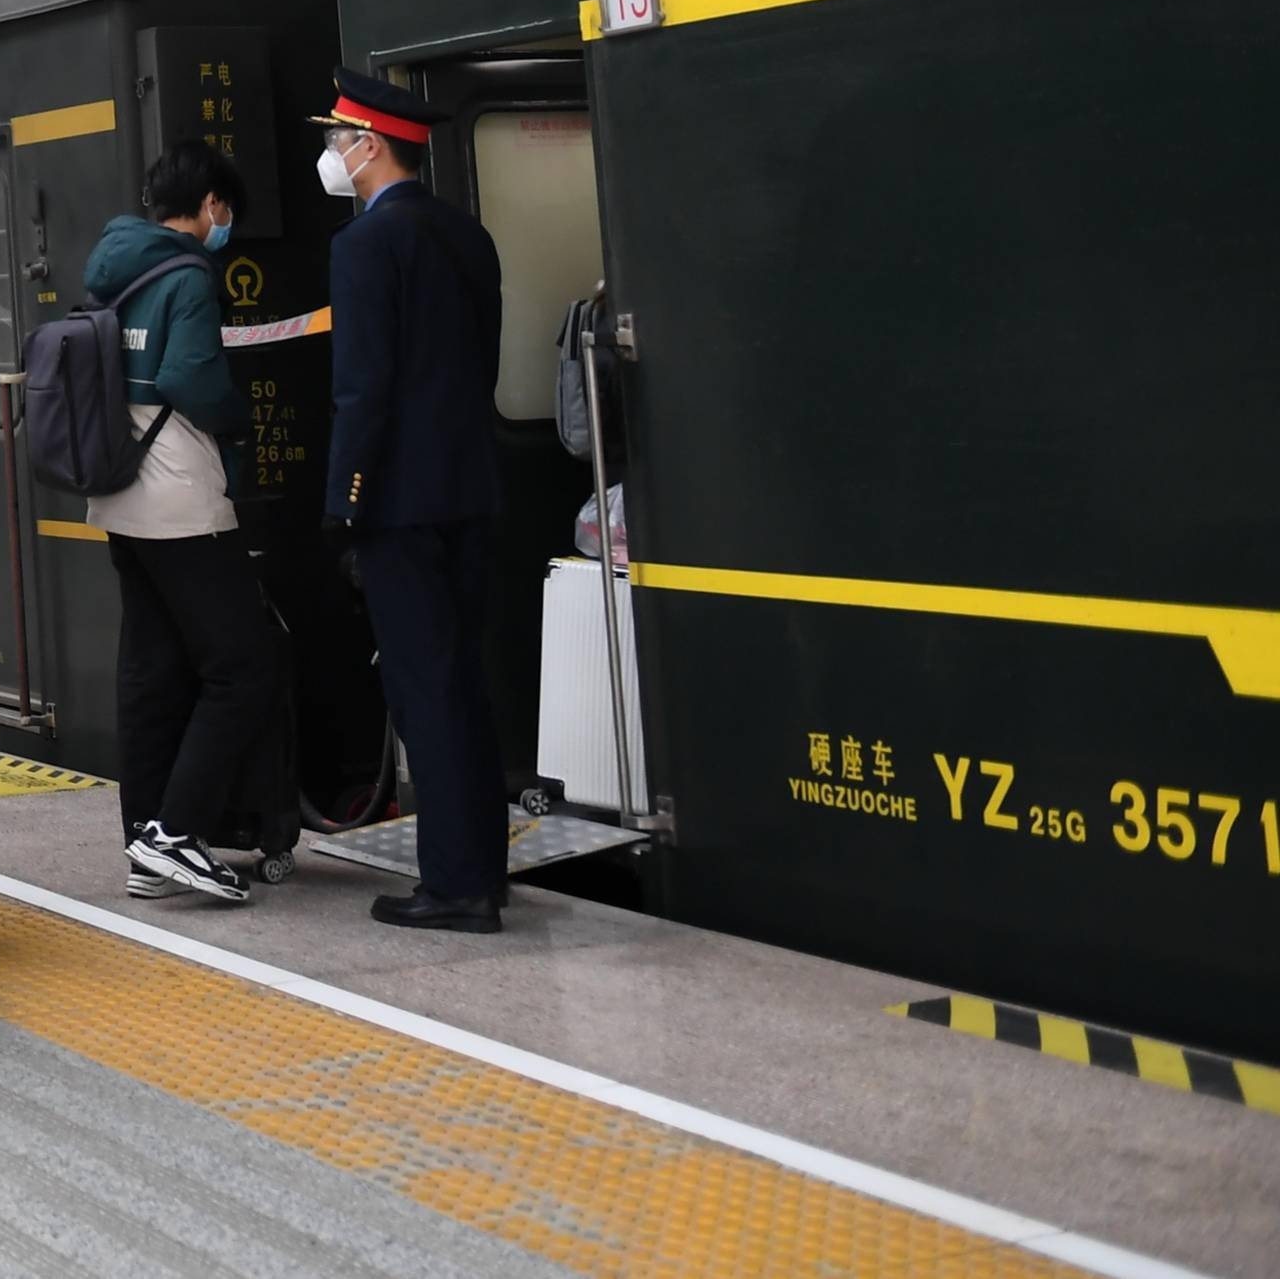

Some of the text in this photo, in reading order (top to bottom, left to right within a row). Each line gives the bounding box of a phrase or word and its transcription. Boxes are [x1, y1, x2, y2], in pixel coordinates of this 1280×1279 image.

[251, 381, 276, 399] 50
[254, 425, 288, 443] 7.5t
[256, 445, 305, 463] 26.6m
[807, 732, 896, 787] 硬座车
[788, 777, 918, 822] YINGZUOCHE
[1109, 779, 1280, 874] 3571
